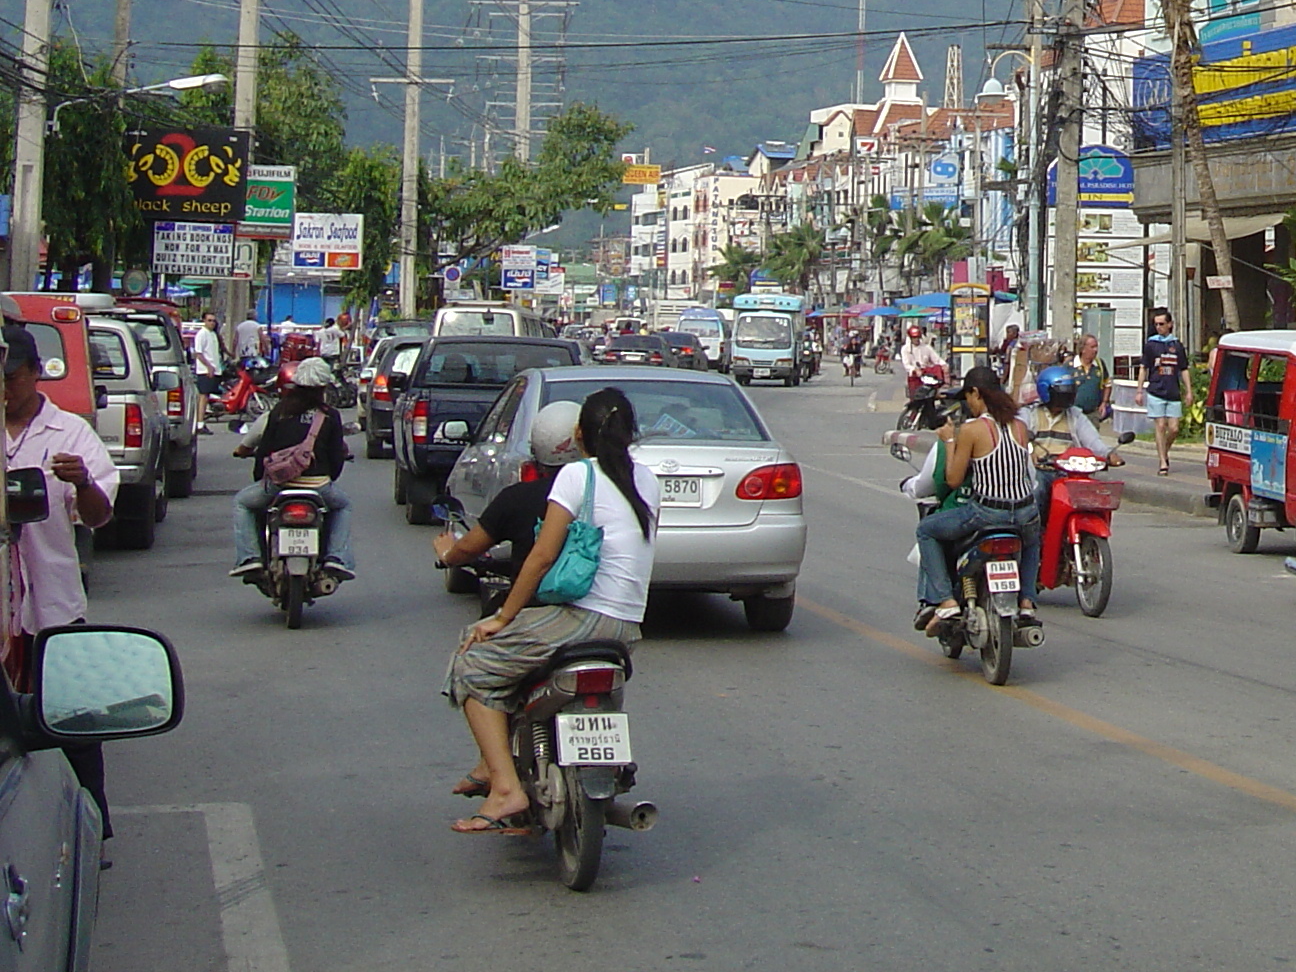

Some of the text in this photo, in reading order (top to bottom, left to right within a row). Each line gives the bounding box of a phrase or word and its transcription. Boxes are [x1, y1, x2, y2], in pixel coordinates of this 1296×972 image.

[252, 169, 291, 177] FUJIFILM
[182, 199, 232, 216] sheep
[245, 205, 290, 219] Station
[155, 231, 232, 244] TAKING BOOKINGS
[326, 221, 359, 243] Seafood
[164, 243, 180, 252] NOW
[185, 245, 201, 253] FOR
[155, 254, 177, 263] QUIZ
[180, 255, 217, 265] TONIGHT
[1215, 425, 1243, 443] BUFFALO
[664, 480, 698, 494] 5870
[577, 747, 615, 760] 266
